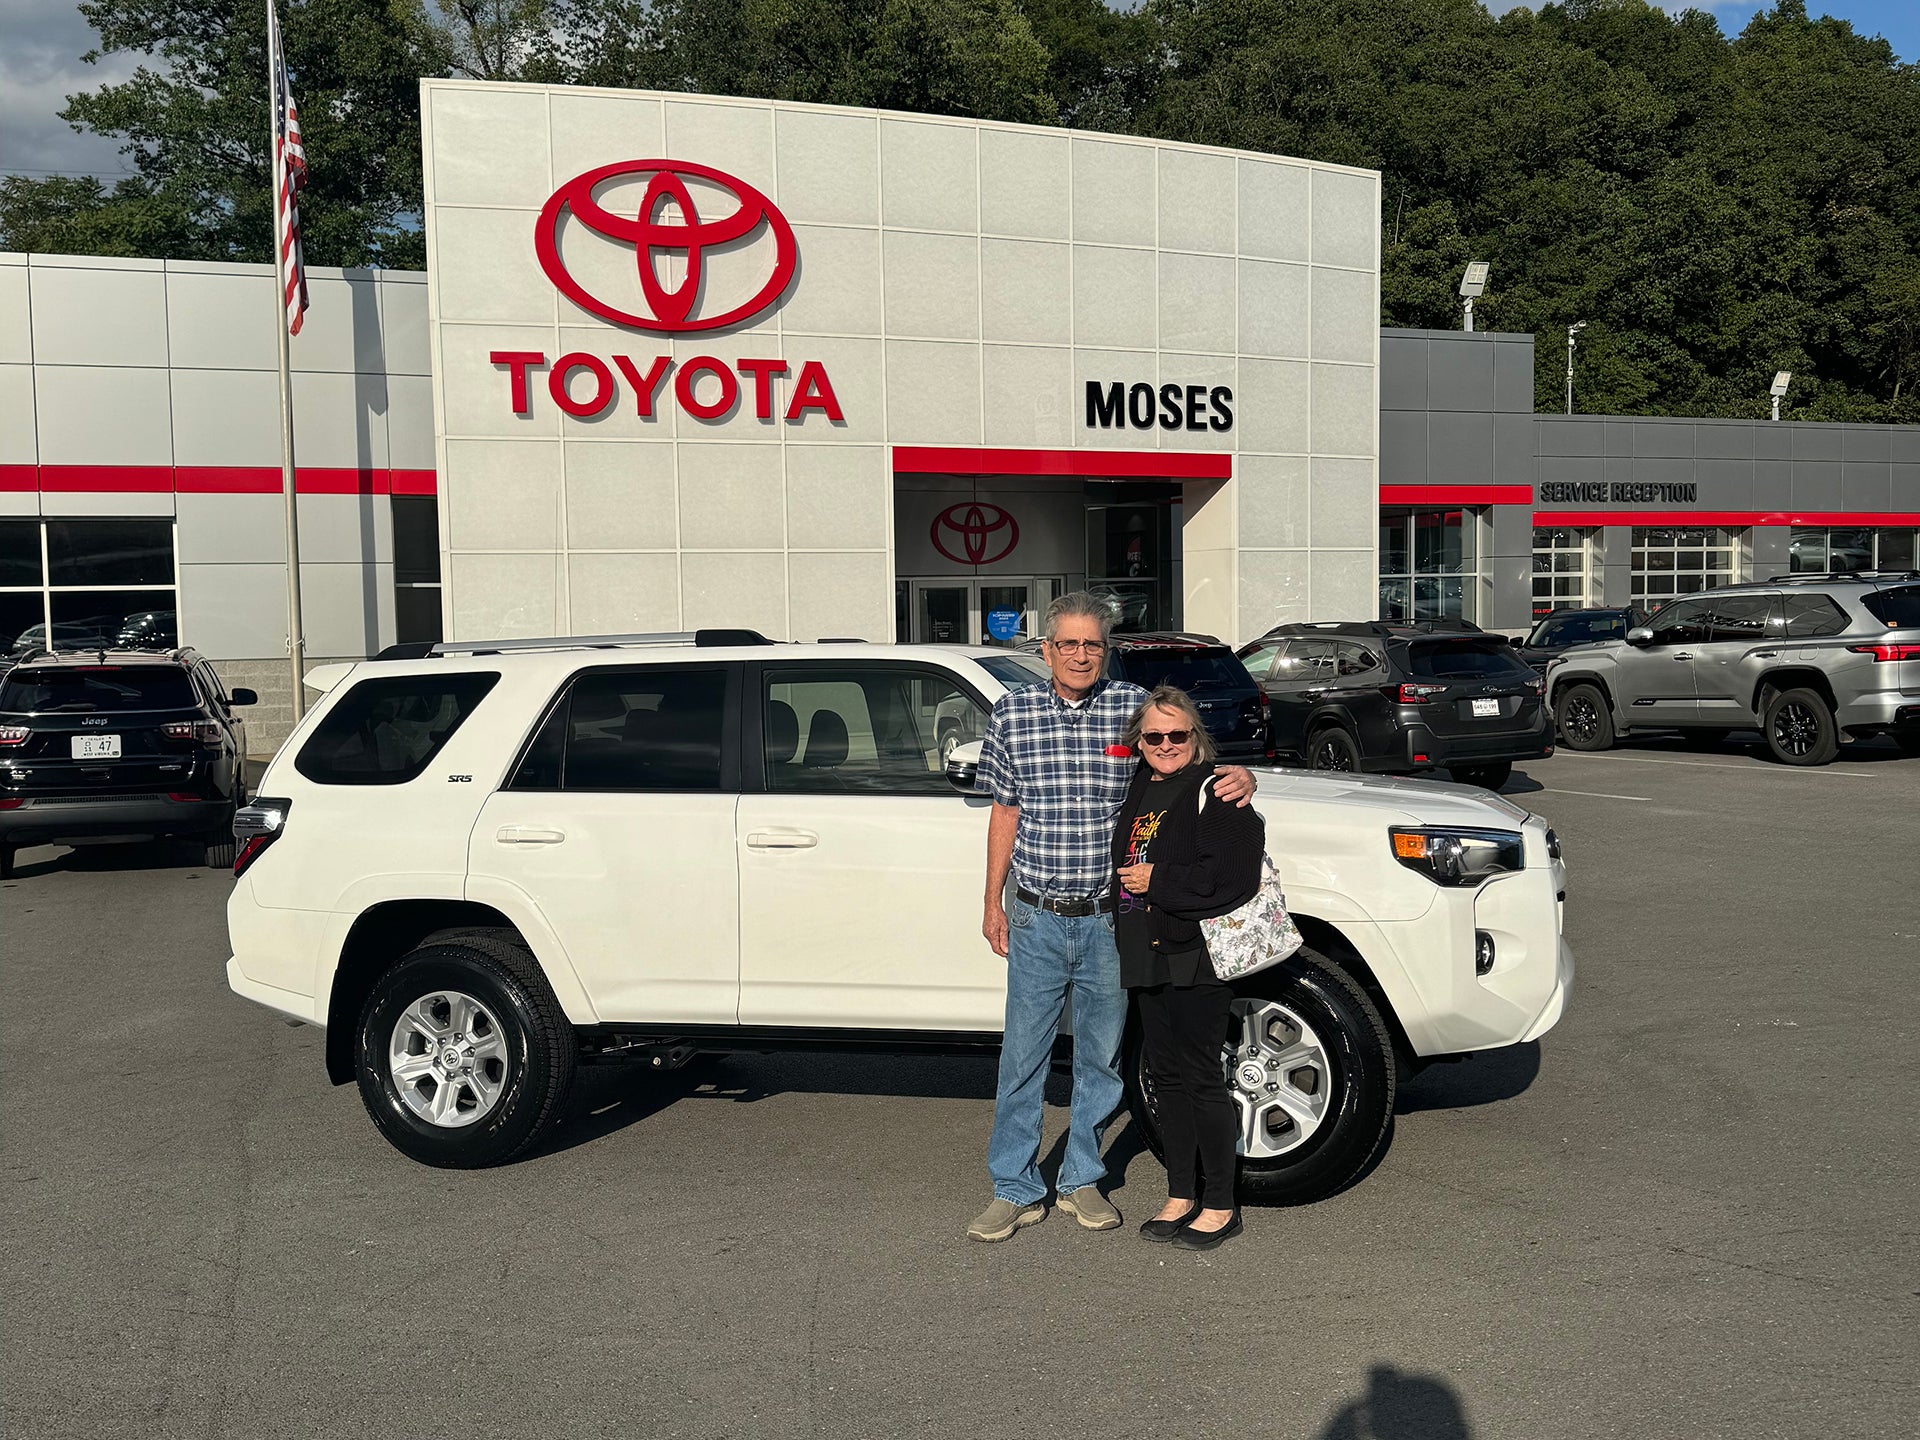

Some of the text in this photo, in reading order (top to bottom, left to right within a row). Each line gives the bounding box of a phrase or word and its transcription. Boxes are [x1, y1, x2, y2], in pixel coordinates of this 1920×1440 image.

[489, 351, 844, 422] TOYOTA
[1086, 381, 1234, 431] MOSES
[1541, 482, 1698, 503] SERVICE RECEPTION
[81, 717, 108, 725] Jeep
[98, 740, 111, 751] 47
[447, 774, 473, 783] SR5
[1131, 811, 1167, 841] Faith
